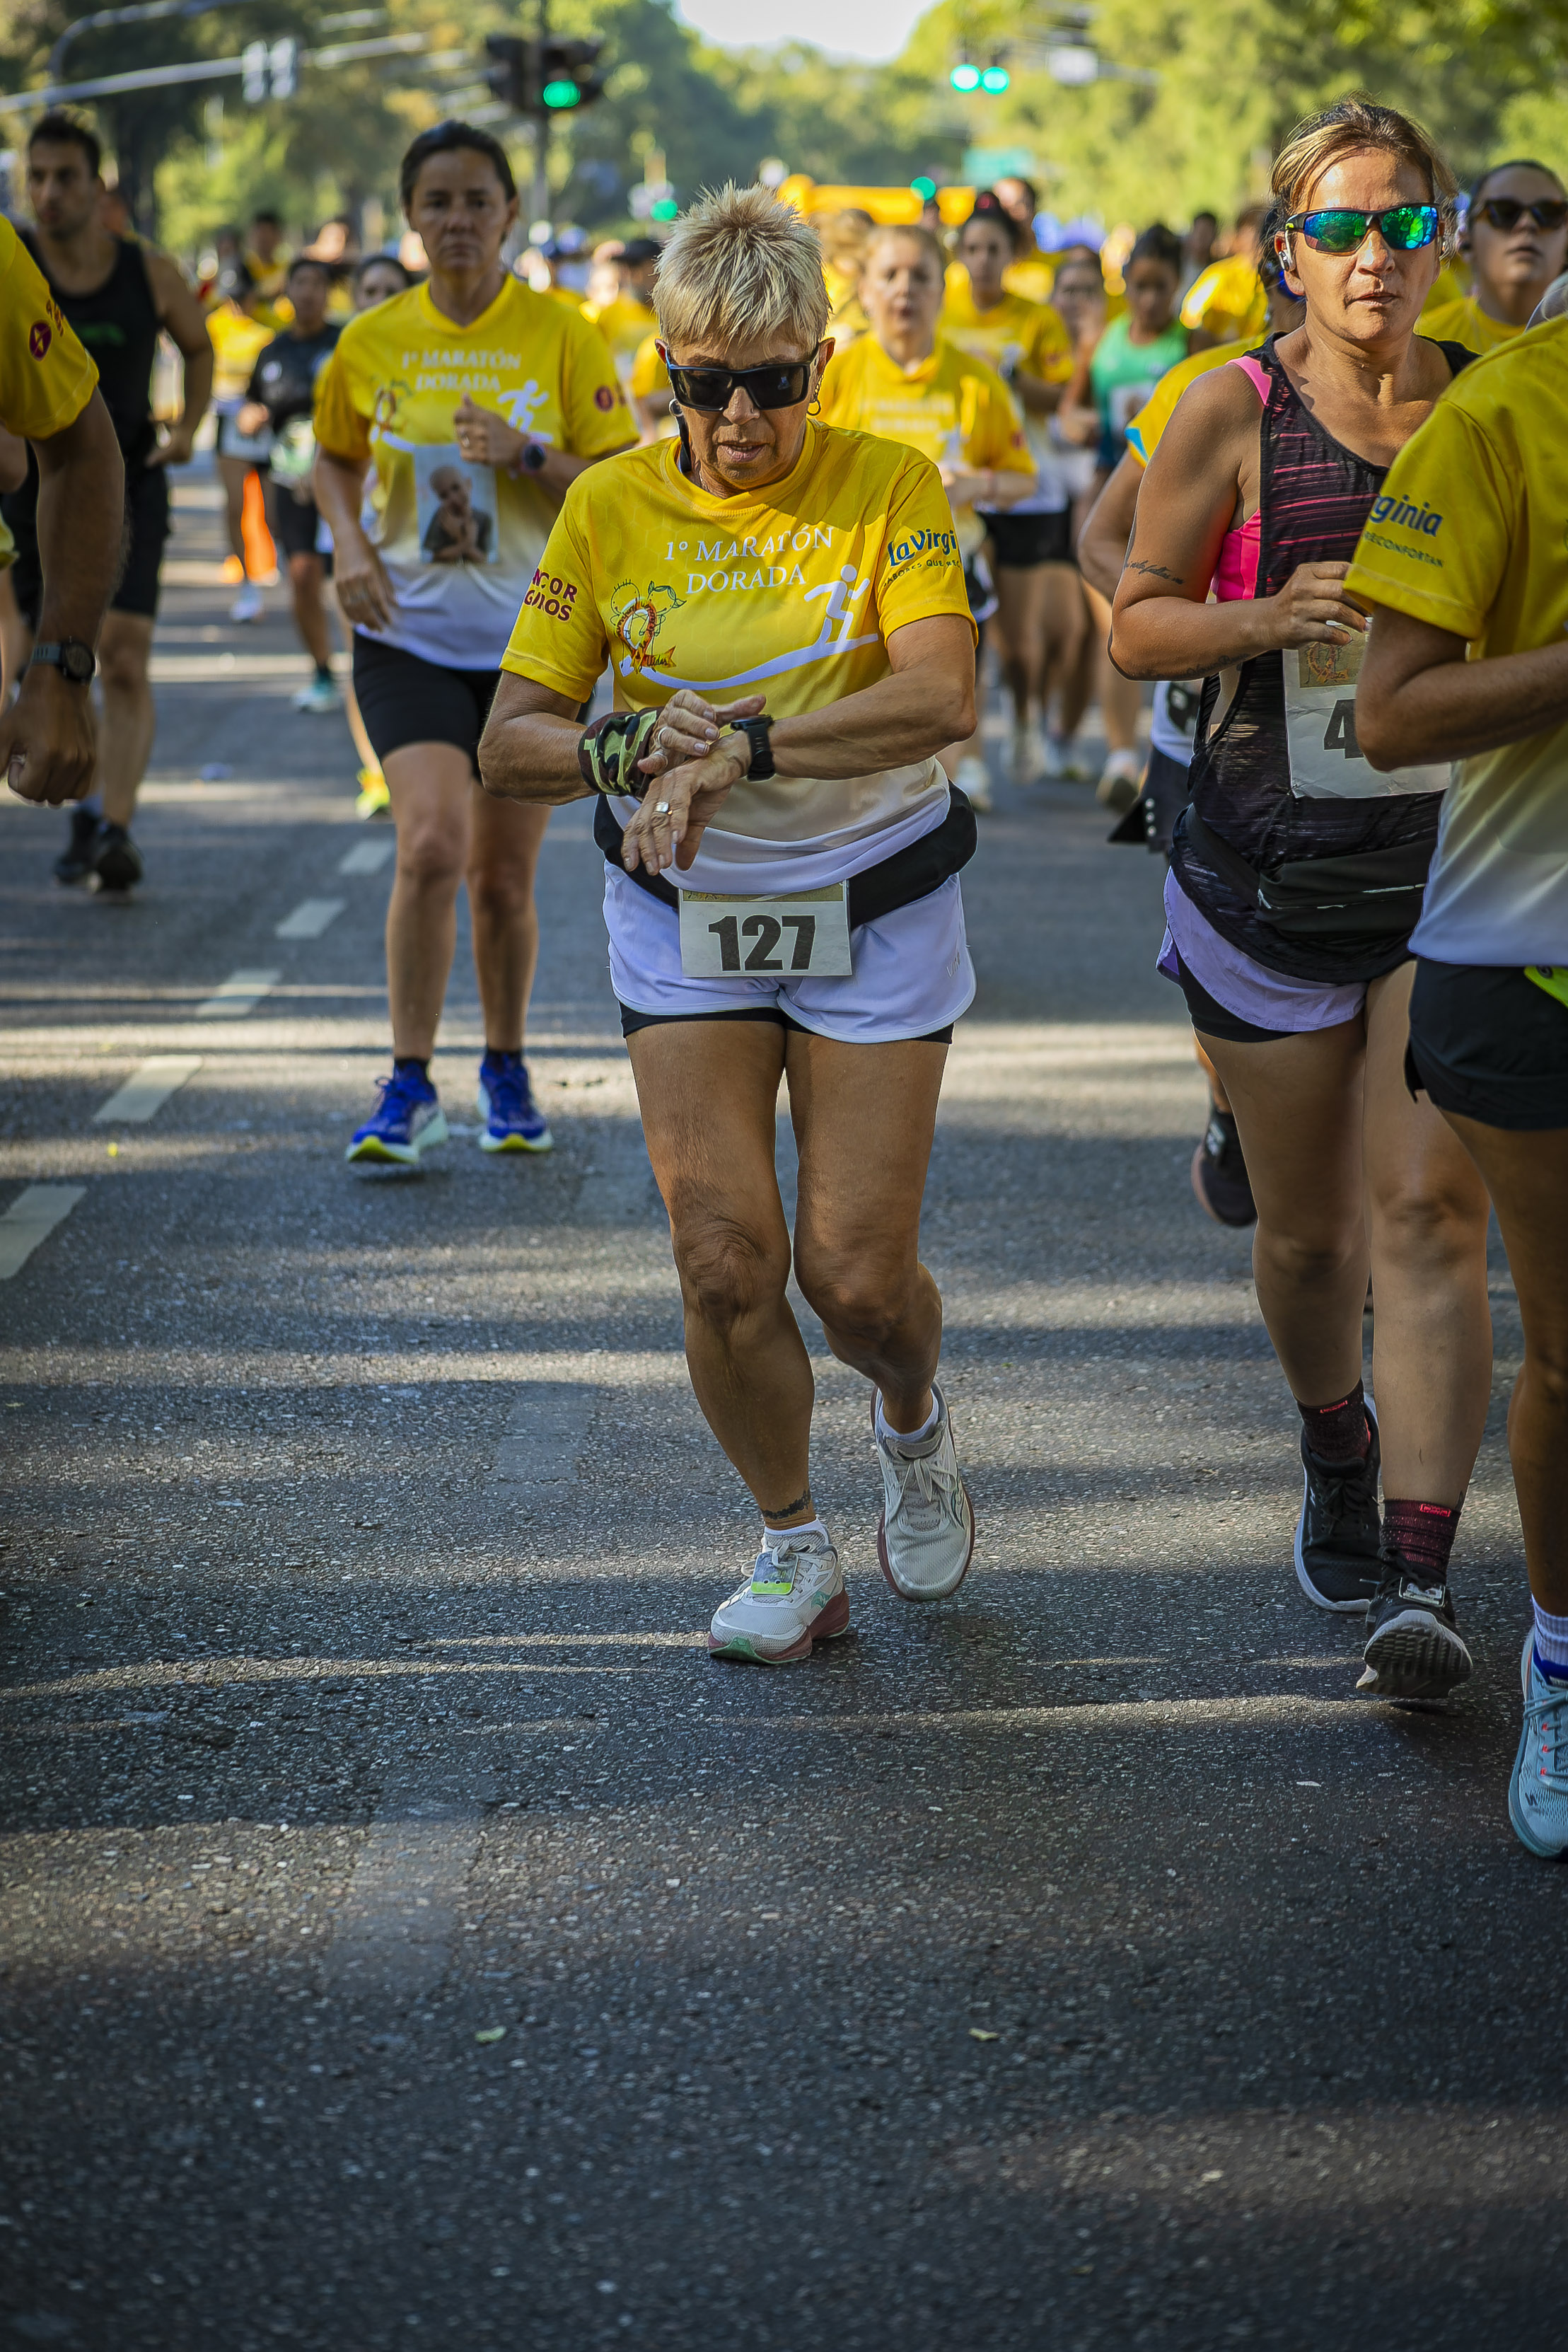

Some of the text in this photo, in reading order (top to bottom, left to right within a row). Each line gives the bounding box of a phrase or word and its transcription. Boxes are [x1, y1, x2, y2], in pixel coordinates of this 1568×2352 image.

[421, 347, 522, 371] MARATÓN
[415, 372, 501, 392] DORADA
[1369, 494, 1444, 538] ginia
[695, 525, 835, 562] MARATÓN
[685, 563, 806, 595] DORADA
[926, 559, 944, 567] QUE
[708, 914, 816, 972] 127
